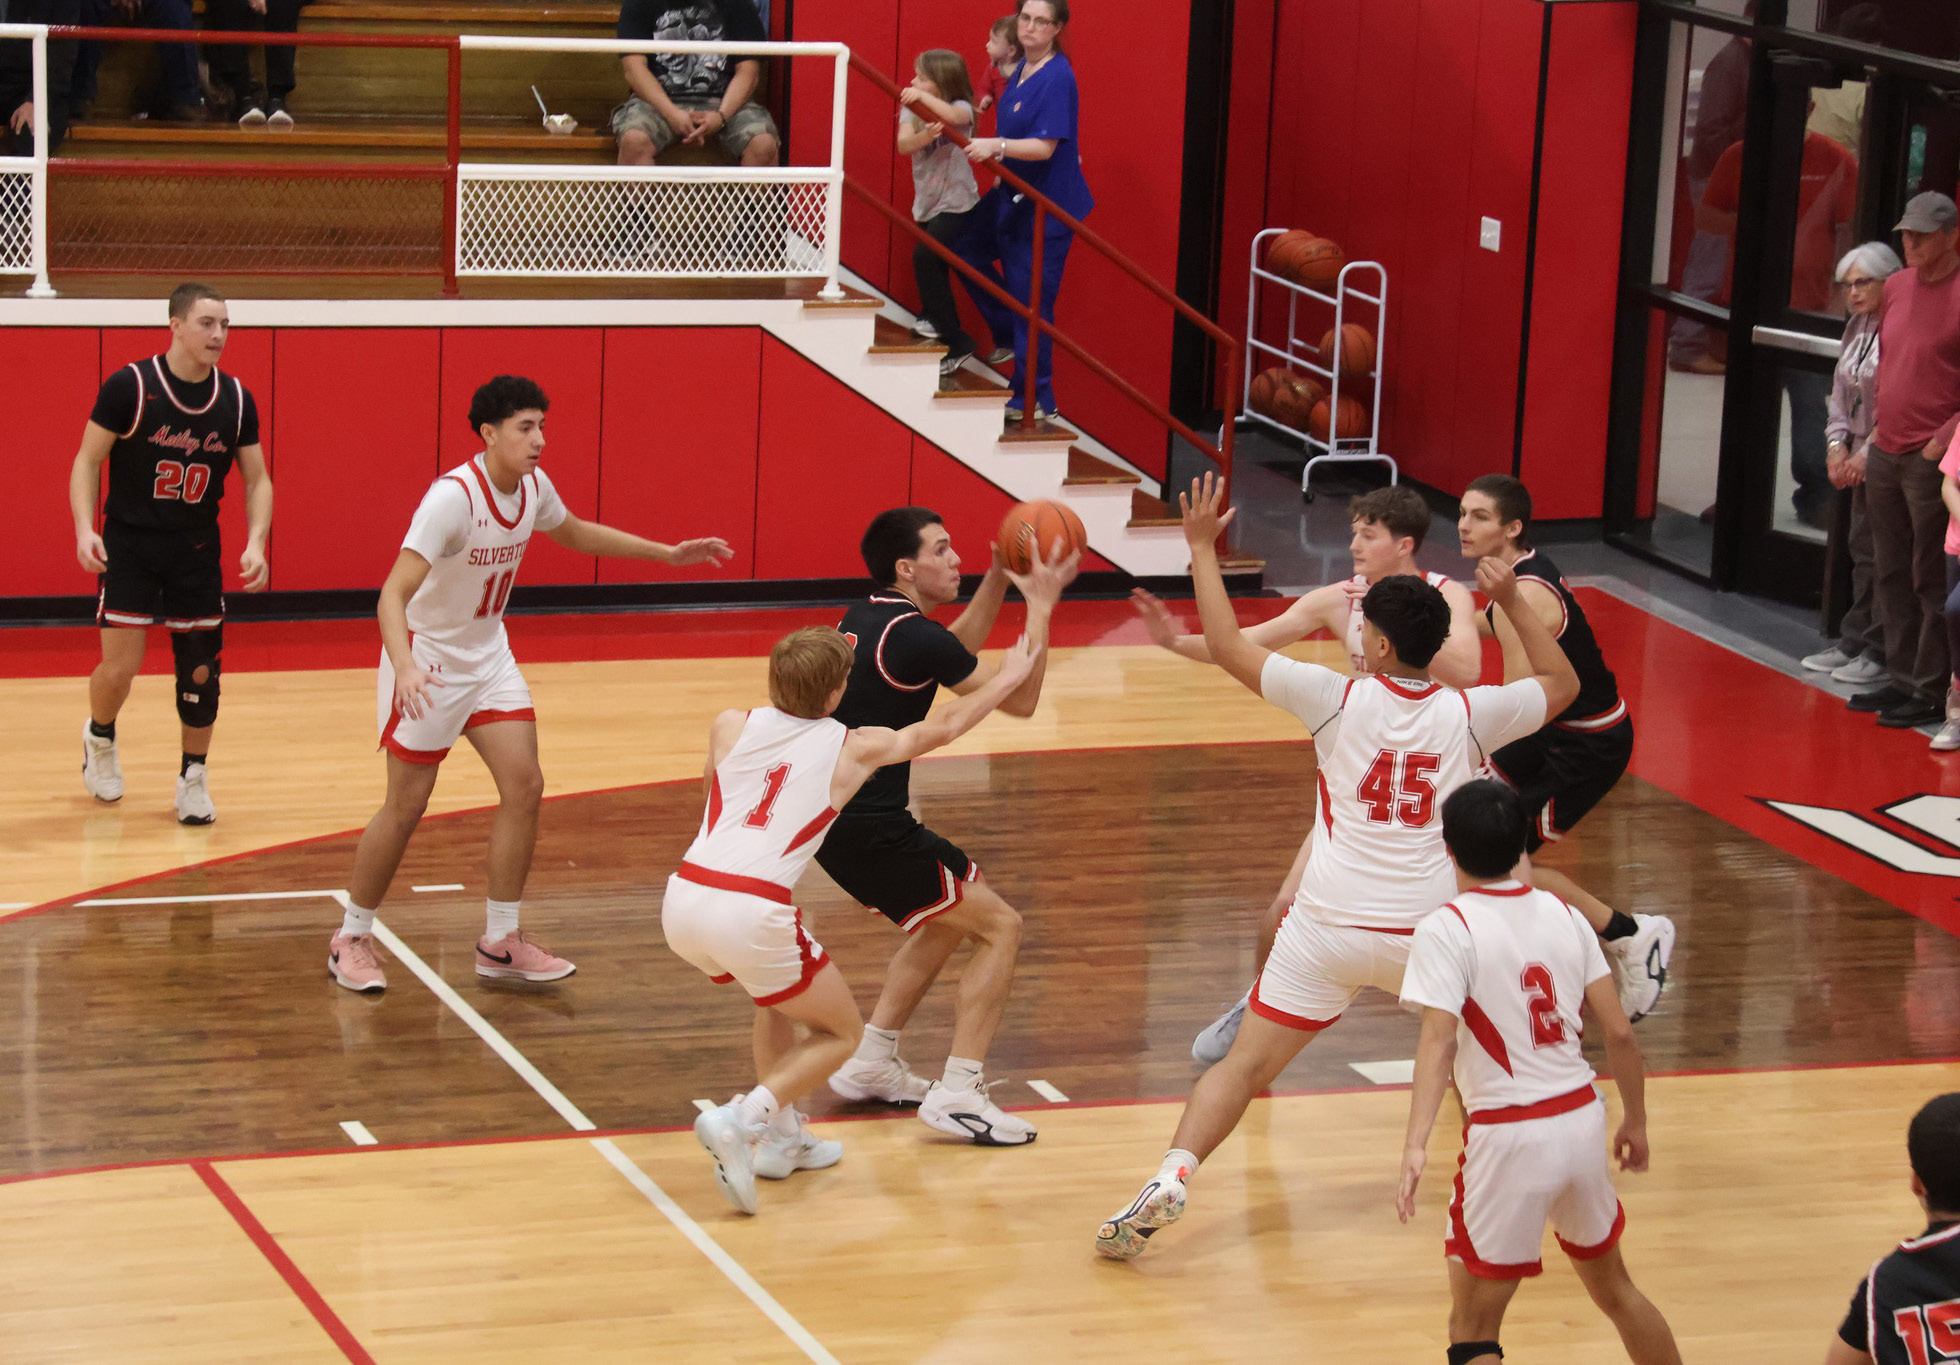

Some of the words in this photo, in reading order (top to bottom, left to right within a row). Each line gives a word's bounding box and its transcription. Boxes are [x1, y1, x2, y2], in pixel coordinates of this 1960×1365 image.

[152, 459, 211, 504] 20
[473, 567, 516, 620] 10
[741, 761, 793, 831] 1
[1357, 748, 1442, 829] 45
[1520, 961, 1568, 1051] 2
[1892, 1297, 1960, 1365] 15
